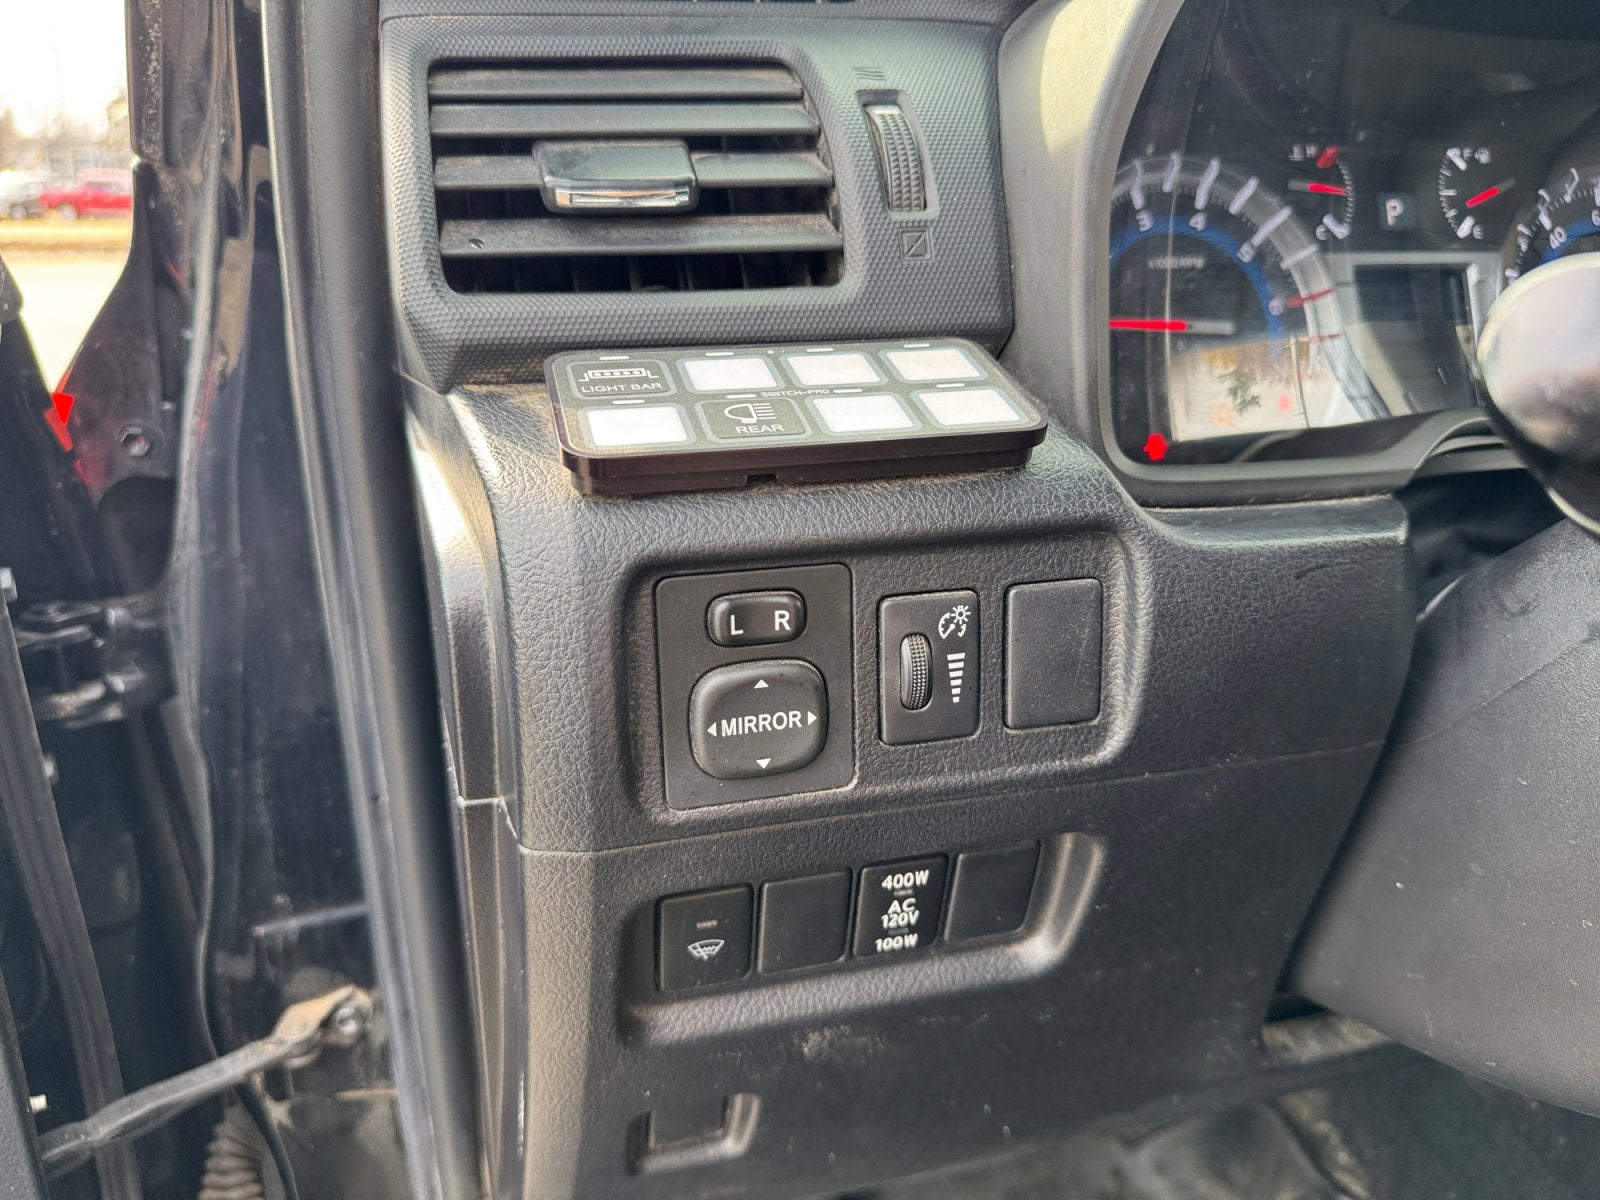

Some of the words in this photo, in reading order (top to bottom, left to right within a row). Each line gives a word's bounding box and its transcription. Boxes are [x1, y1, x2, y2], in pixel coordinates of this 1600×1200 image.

[1136, 209, 1153, 231] 3
[1189, 211, 1206, 231] 4
[1385, 199, 1403, 225] P
[1472, 224, 1484, 239] E
[1549, 226, 1567, 249] 40
[1237, 242, 1254, 263] 5
[581, 384, 627, 393] LIGHT
[630, 382, 663, 391] BAR
[760, 388, 829, 397] SWITCH-PRO
[735, 424, 785, 434] REAR
[730, 614, 744, 636] L
[774, 610, 791, 631] R
[721, 710, 803, 737] MIRROR
[881, 869, 930, 891] 400W
[887, 897, 917, 915] AC
[881, 909, 920, 930] 120V
[875, 933, 919, 953] 100W
